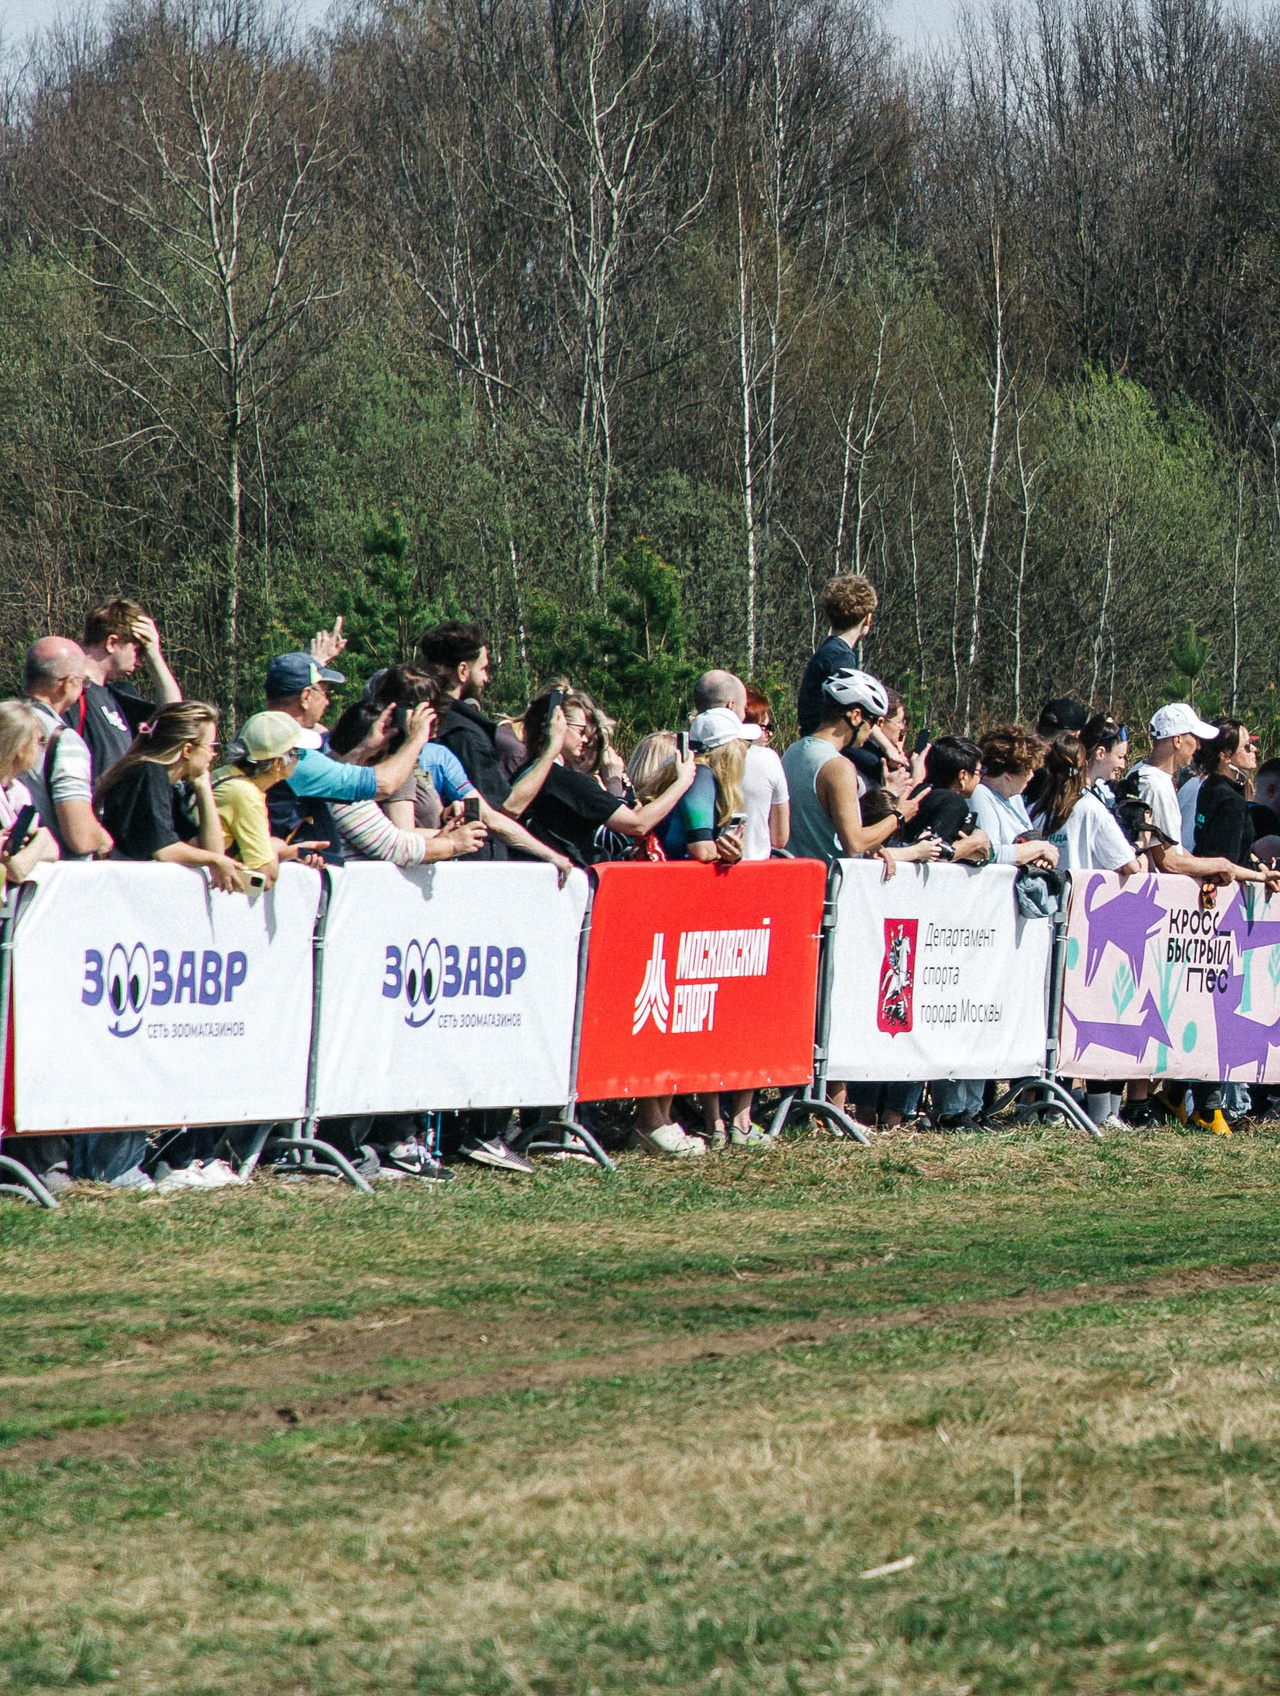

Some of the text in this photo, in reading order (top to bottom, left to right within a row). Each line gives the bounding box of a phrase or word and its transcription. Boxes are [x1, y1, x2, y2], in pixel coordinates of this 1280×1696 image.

[1168, 908, 1220, 936] КРОСС
[675, 917, 771, 980] МОСКОВСКИЙ
[925, 922, 996, 954] Департамент
[923, 966, 960, 992] спорта
[438, 1012, 522, 1029] СЕТЬ ЗООМАГАЗИНОВ
[671, 983, 719, 1033] СПОРТ
[920, 999, 1003, 1029] города Москвы
[147, 1021, 245, 1039] СЕТЬ ЗООМАГАЗИНОВ
